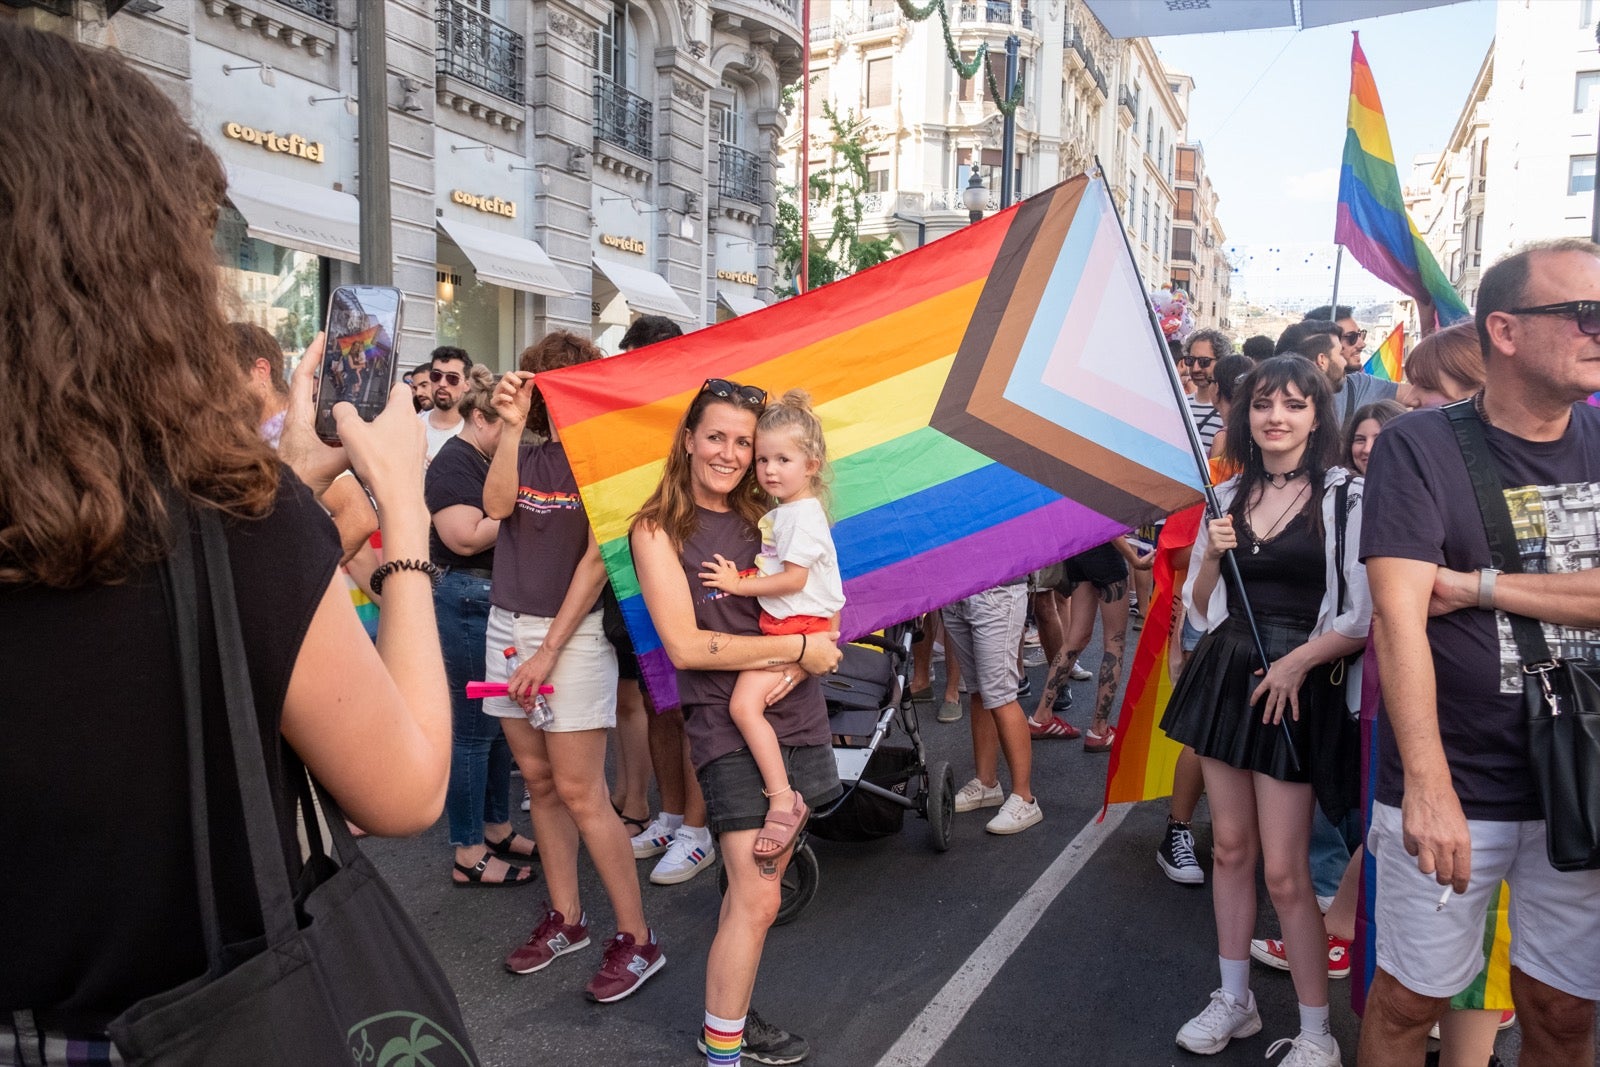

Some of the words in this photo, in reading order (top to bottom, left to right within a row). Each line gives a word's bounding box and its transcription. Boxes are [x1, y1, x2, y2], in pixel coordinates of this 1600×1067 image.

[224, 121, 325, 163] cortefiel
[451, 188, 517, 219] cortefiel
[600, 233, 646, 255] cortefiel
